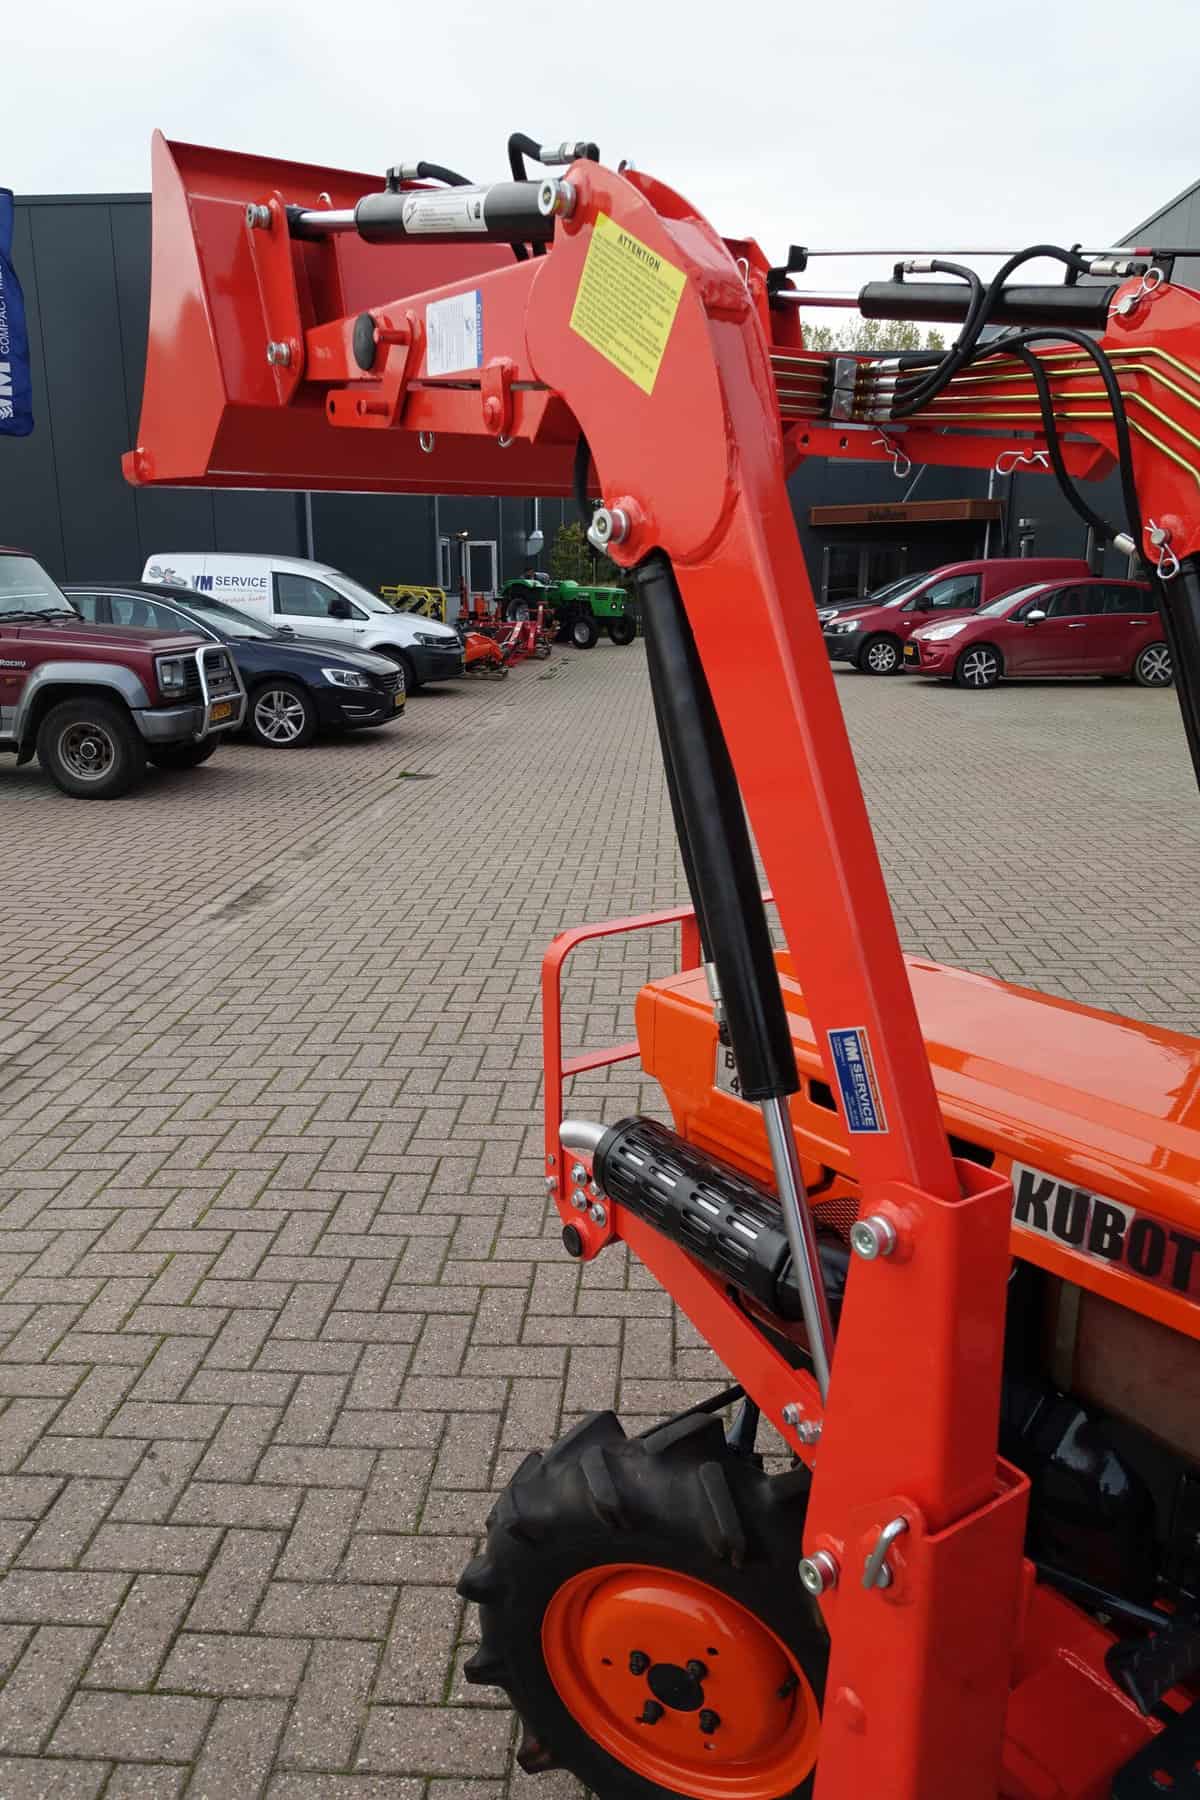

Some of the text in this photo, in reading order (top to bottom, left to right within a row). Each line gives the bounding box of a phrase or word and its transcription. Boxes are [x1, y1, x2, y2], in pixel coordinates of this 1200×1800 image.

[617, 233, 661, 271] ATTENTION
[215, 576, 267, 588] SERVICE
[843, 1035, 875, 1127] VM SERVICE
